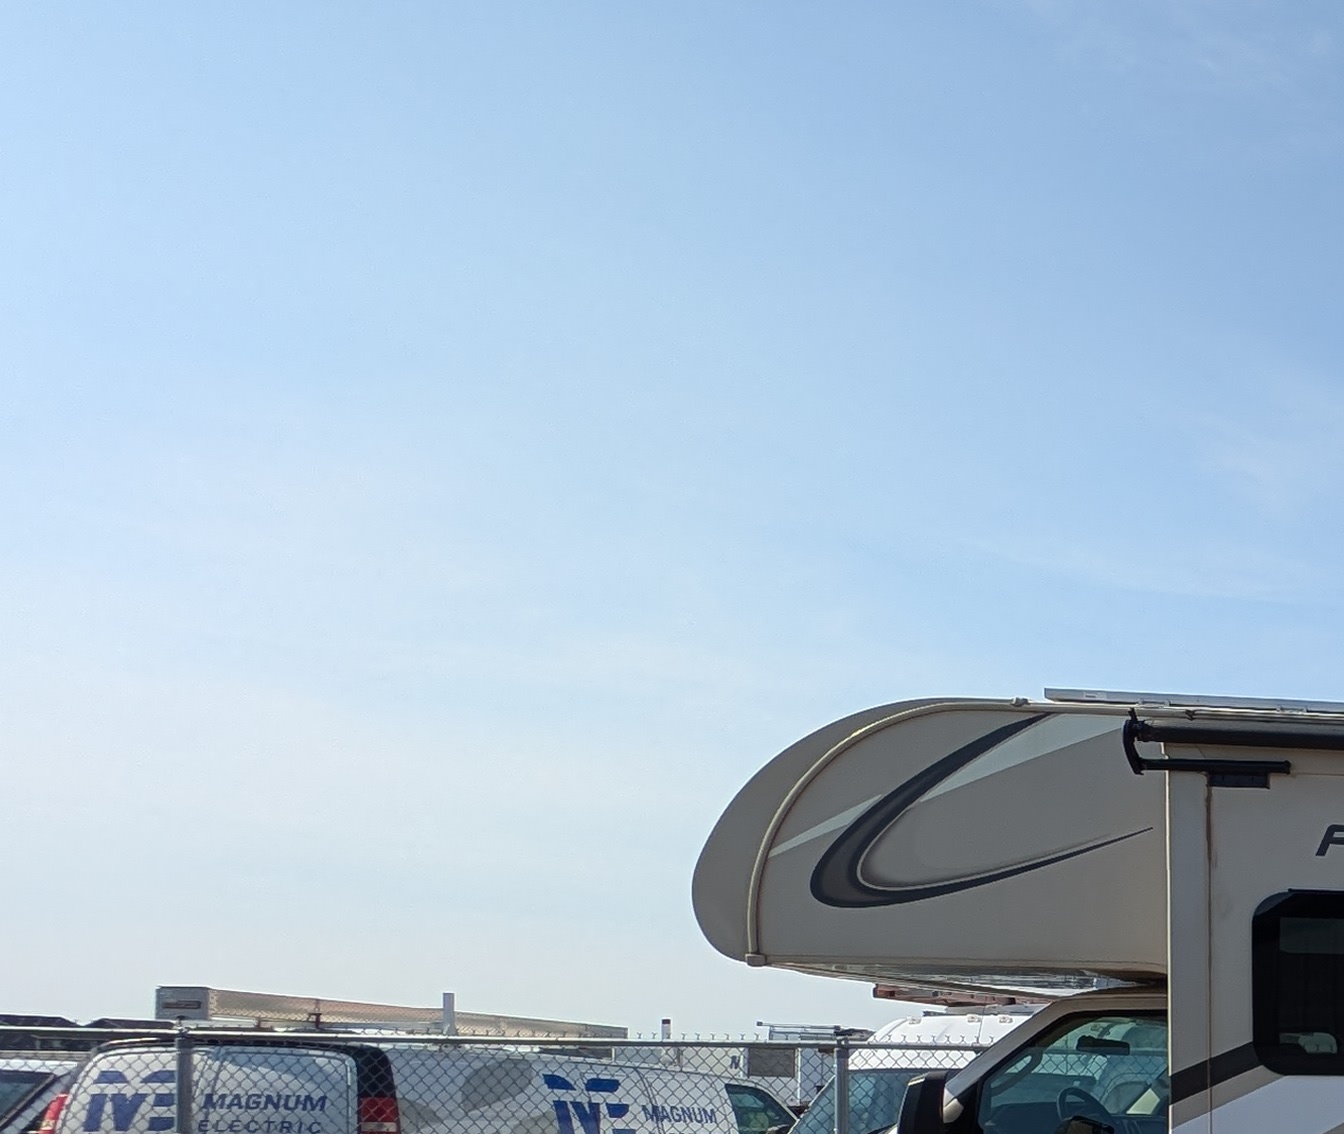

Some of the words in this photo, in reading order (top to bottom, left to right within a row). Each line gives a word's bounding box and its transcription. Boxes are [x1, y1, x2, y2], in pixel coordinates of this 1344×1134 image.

[201, 1093, 328, 1112] MAGNUM
[641, 1103, 717, 1124] MAGNUM
[198, 1119, 321, 1134] ELECTRIC
